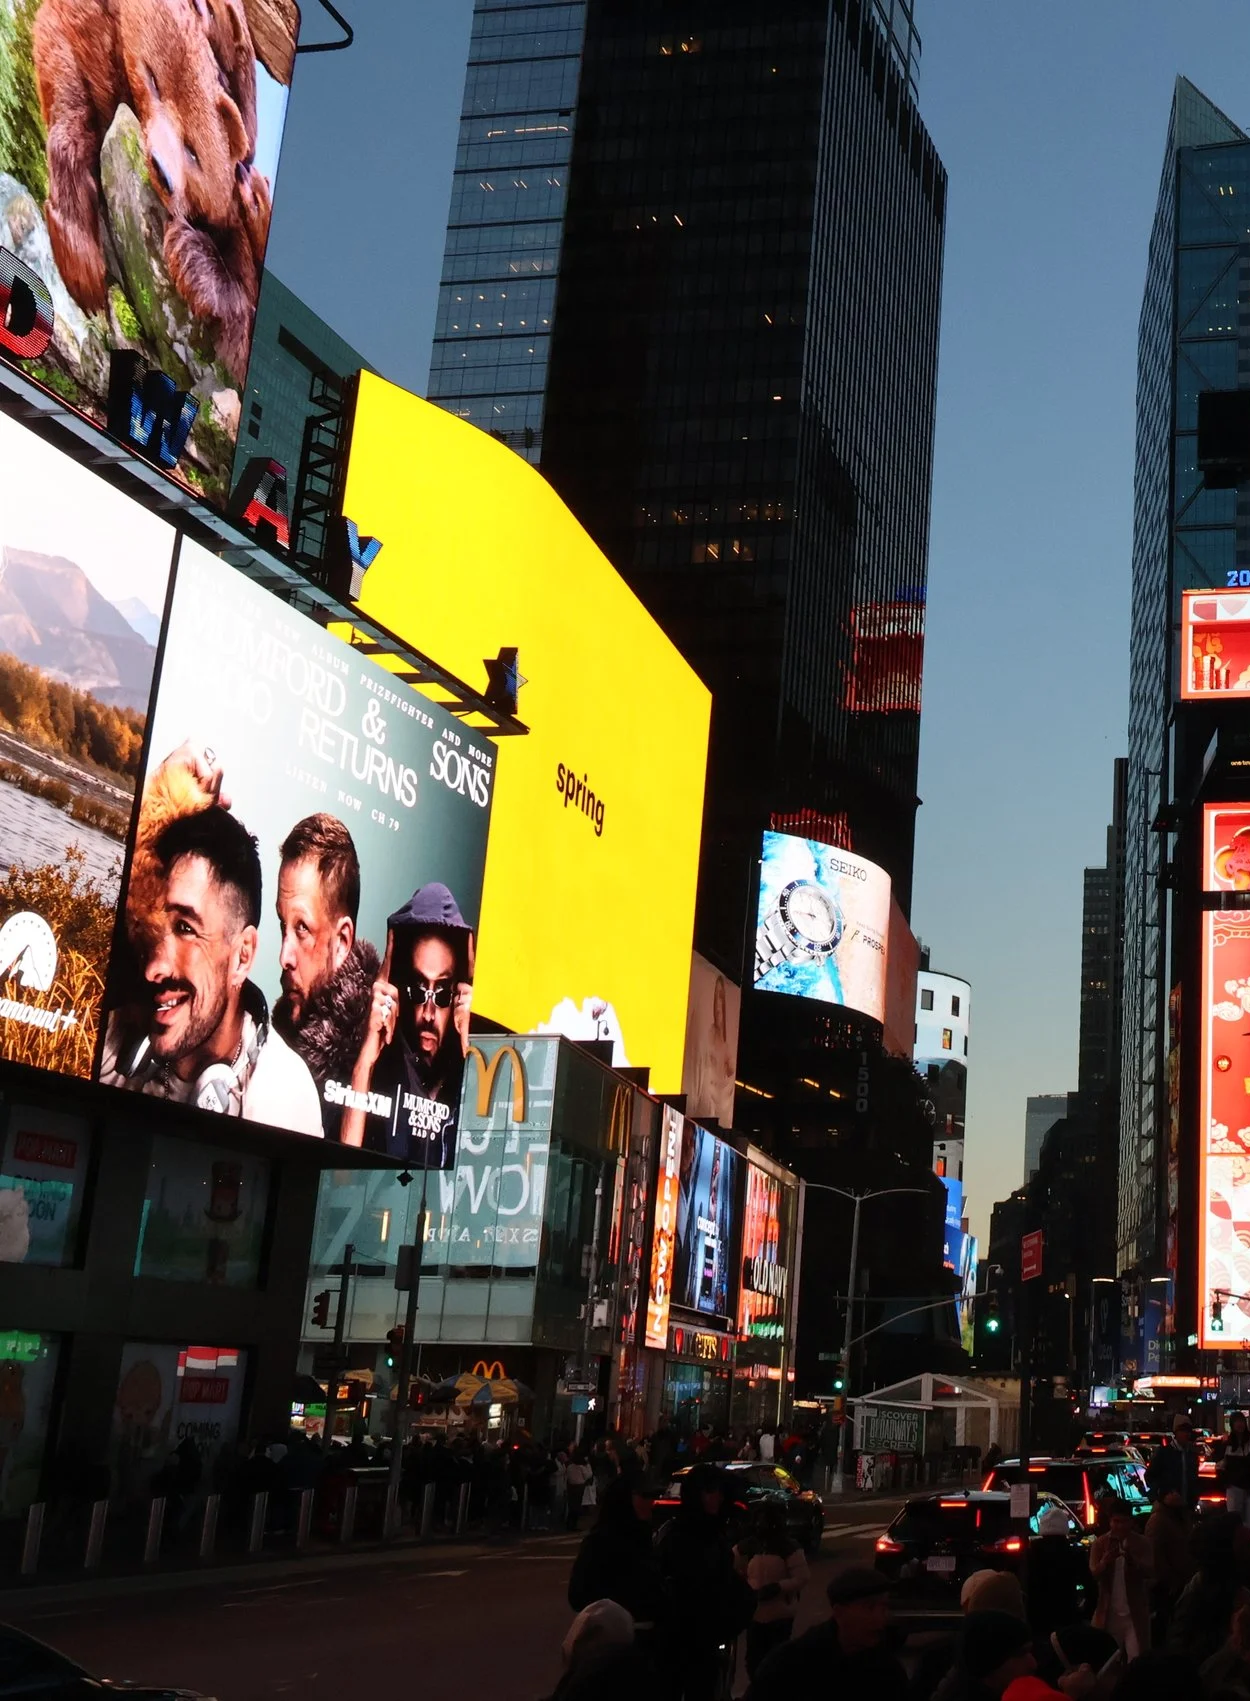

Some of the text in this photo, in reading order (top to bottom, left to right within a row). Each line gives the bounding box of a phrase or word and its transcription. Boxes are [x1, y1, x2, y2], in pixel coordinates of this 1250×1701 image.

[312, 644, 350, 675] ALBUM
[359, 673, 434, 729] PRIZEFIGHTER
[441, 727, 462, 747] AND
[468, 744, 493, 768] MORE
[298, 705, 418, 808] RETURNS
[361, 697, 387, 745] &
[429, 740, 491, 807] SONS
[337, 790, 362, 812] NOW
[371, 808, 387, 825] CH
[388, 816, 400, 832] 79
[556, 763, 605, 837] spring
[829, 858, 868, 882] SEIKO
[323, 1079, 393, 1119] SiriusXM
[402, 1092, 450, 1121] MUMFORD
[411, 1129, 436, 1141] RADO
[652, 1117, 677, 1332] NOW OPEN!
[752, 1256, 789, 1299] OLD NAVY
[868, 1439, 917, 1451] SECRETS
[869, 1418, 919, 1442] BROADWAY'S
